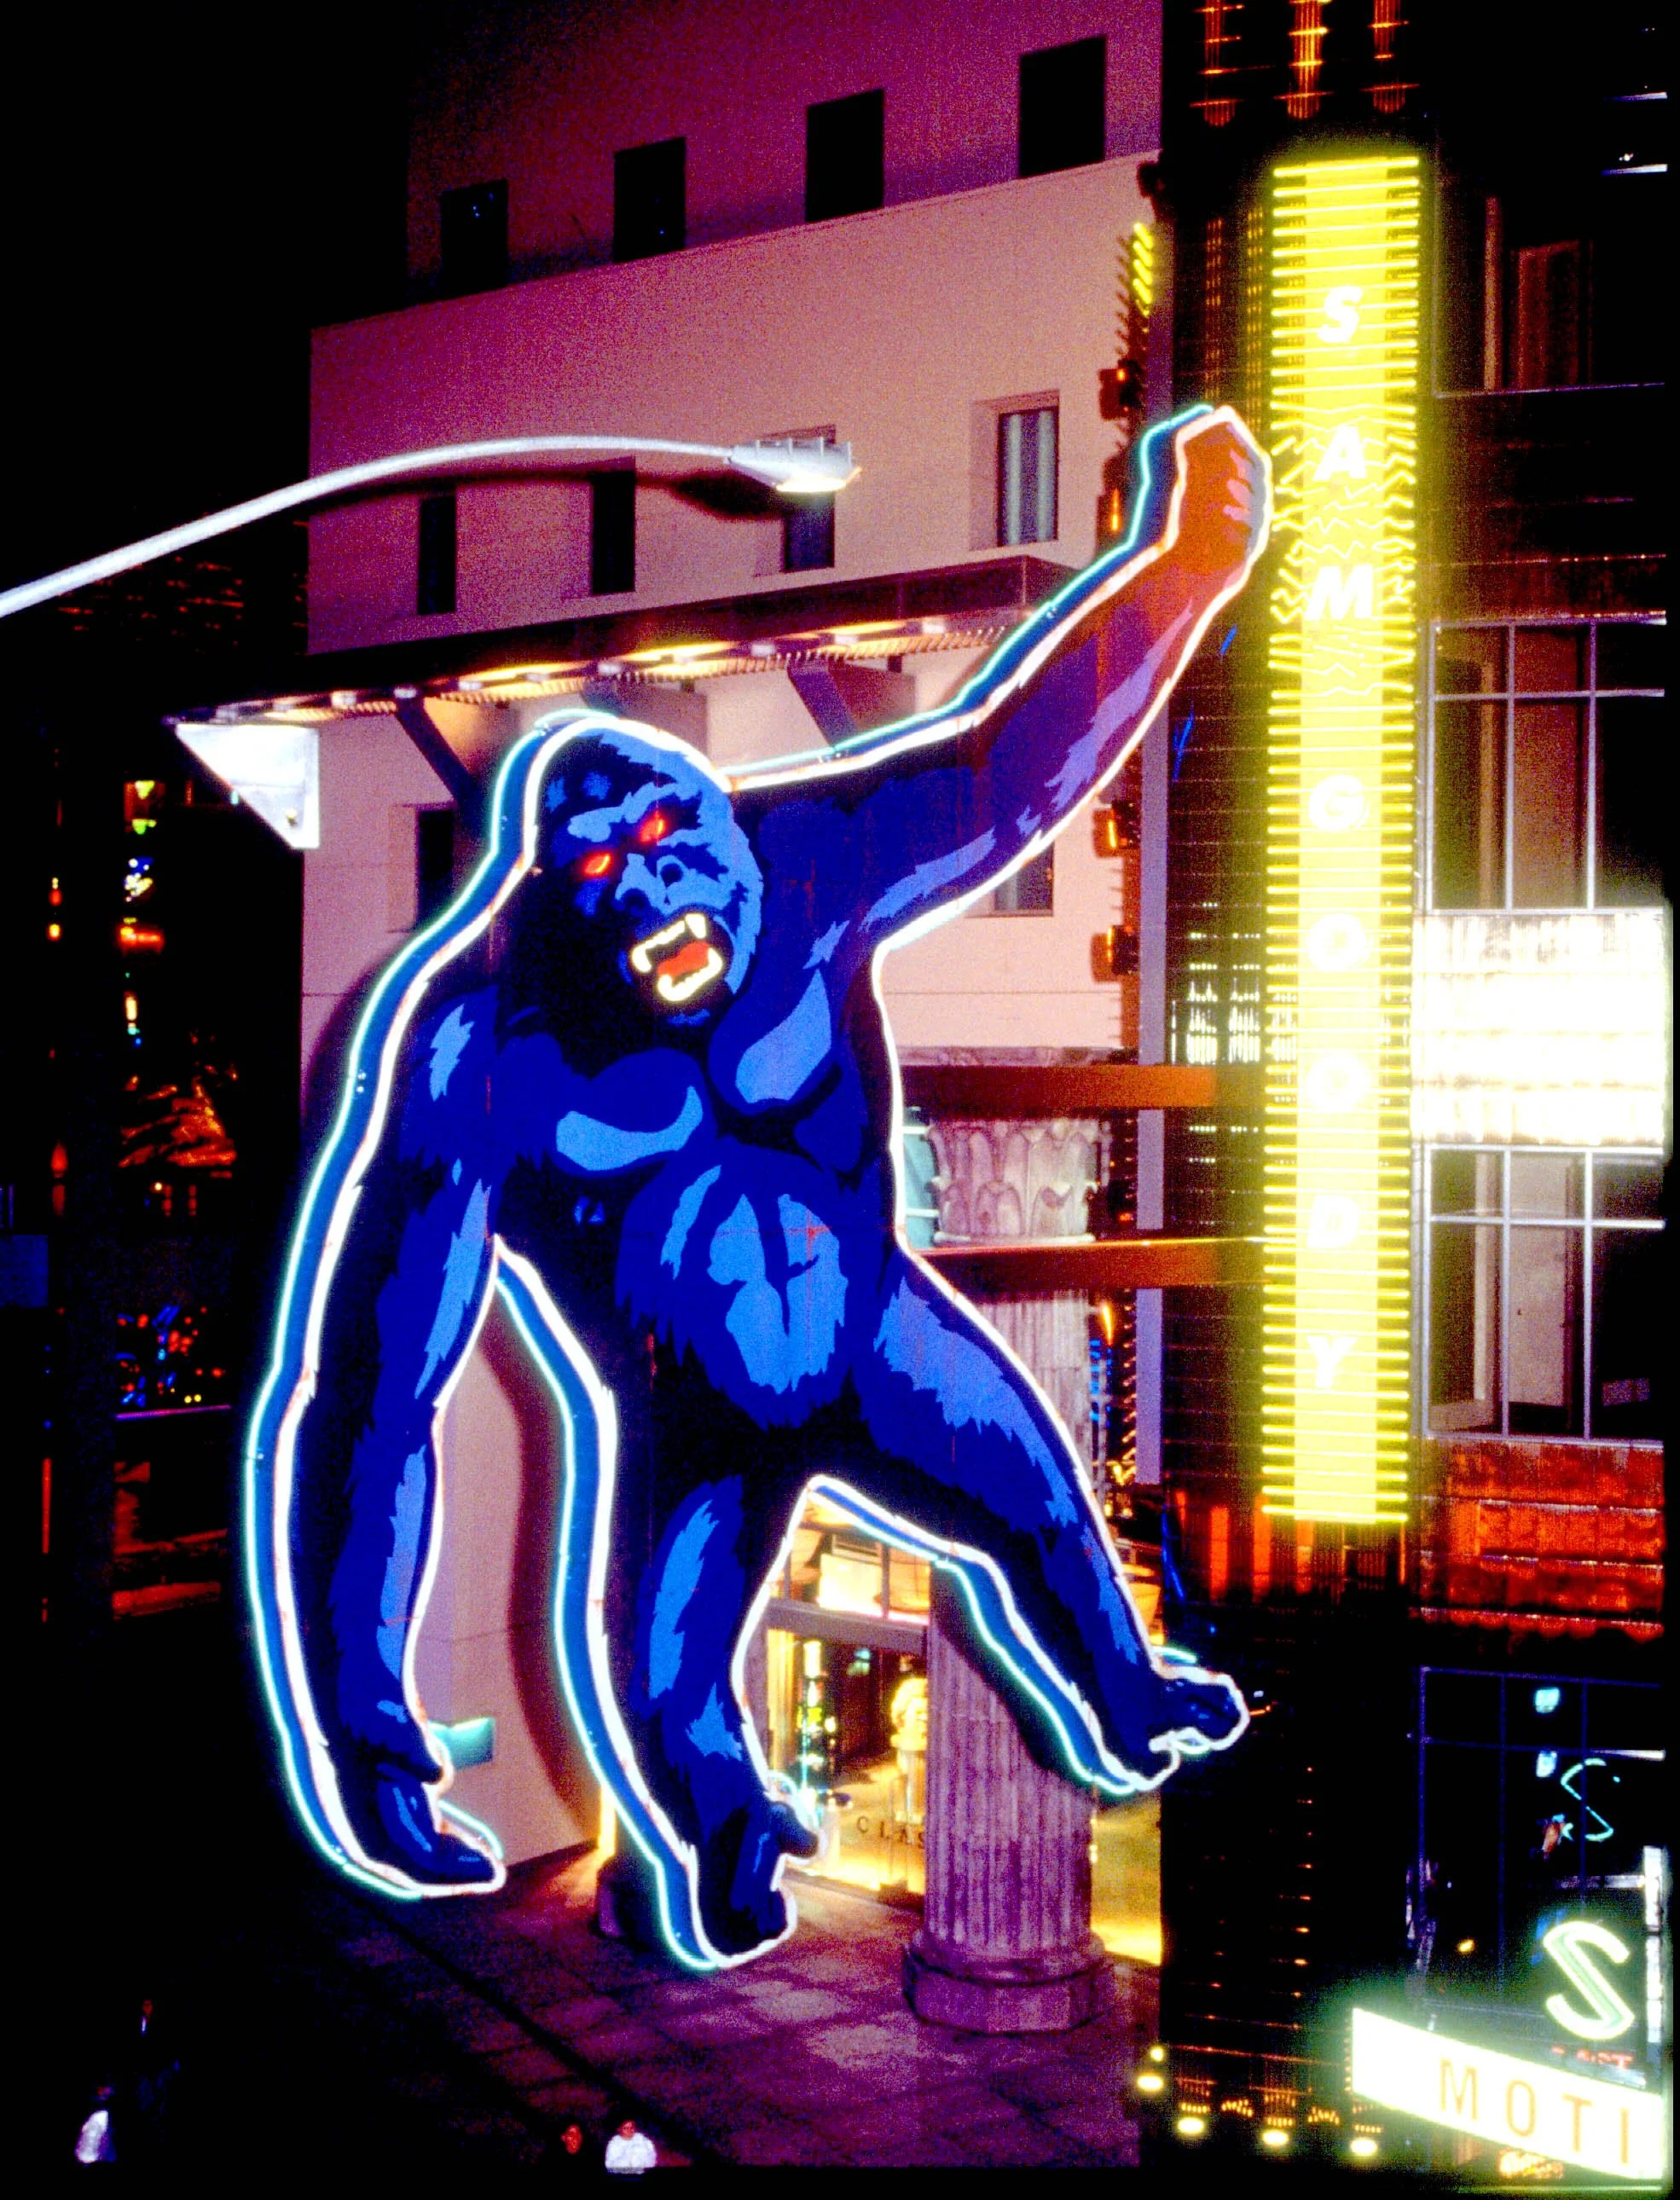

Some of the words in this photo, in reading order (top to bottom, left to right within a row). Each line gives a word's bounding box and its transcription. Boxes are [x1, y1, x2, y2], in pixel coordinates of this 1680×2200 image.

[1306, 284, 1373, 620] SAM
[1307, 773, 1370, 1388] GOODY
[1439, 2059, 1631, 2166] MOTI
